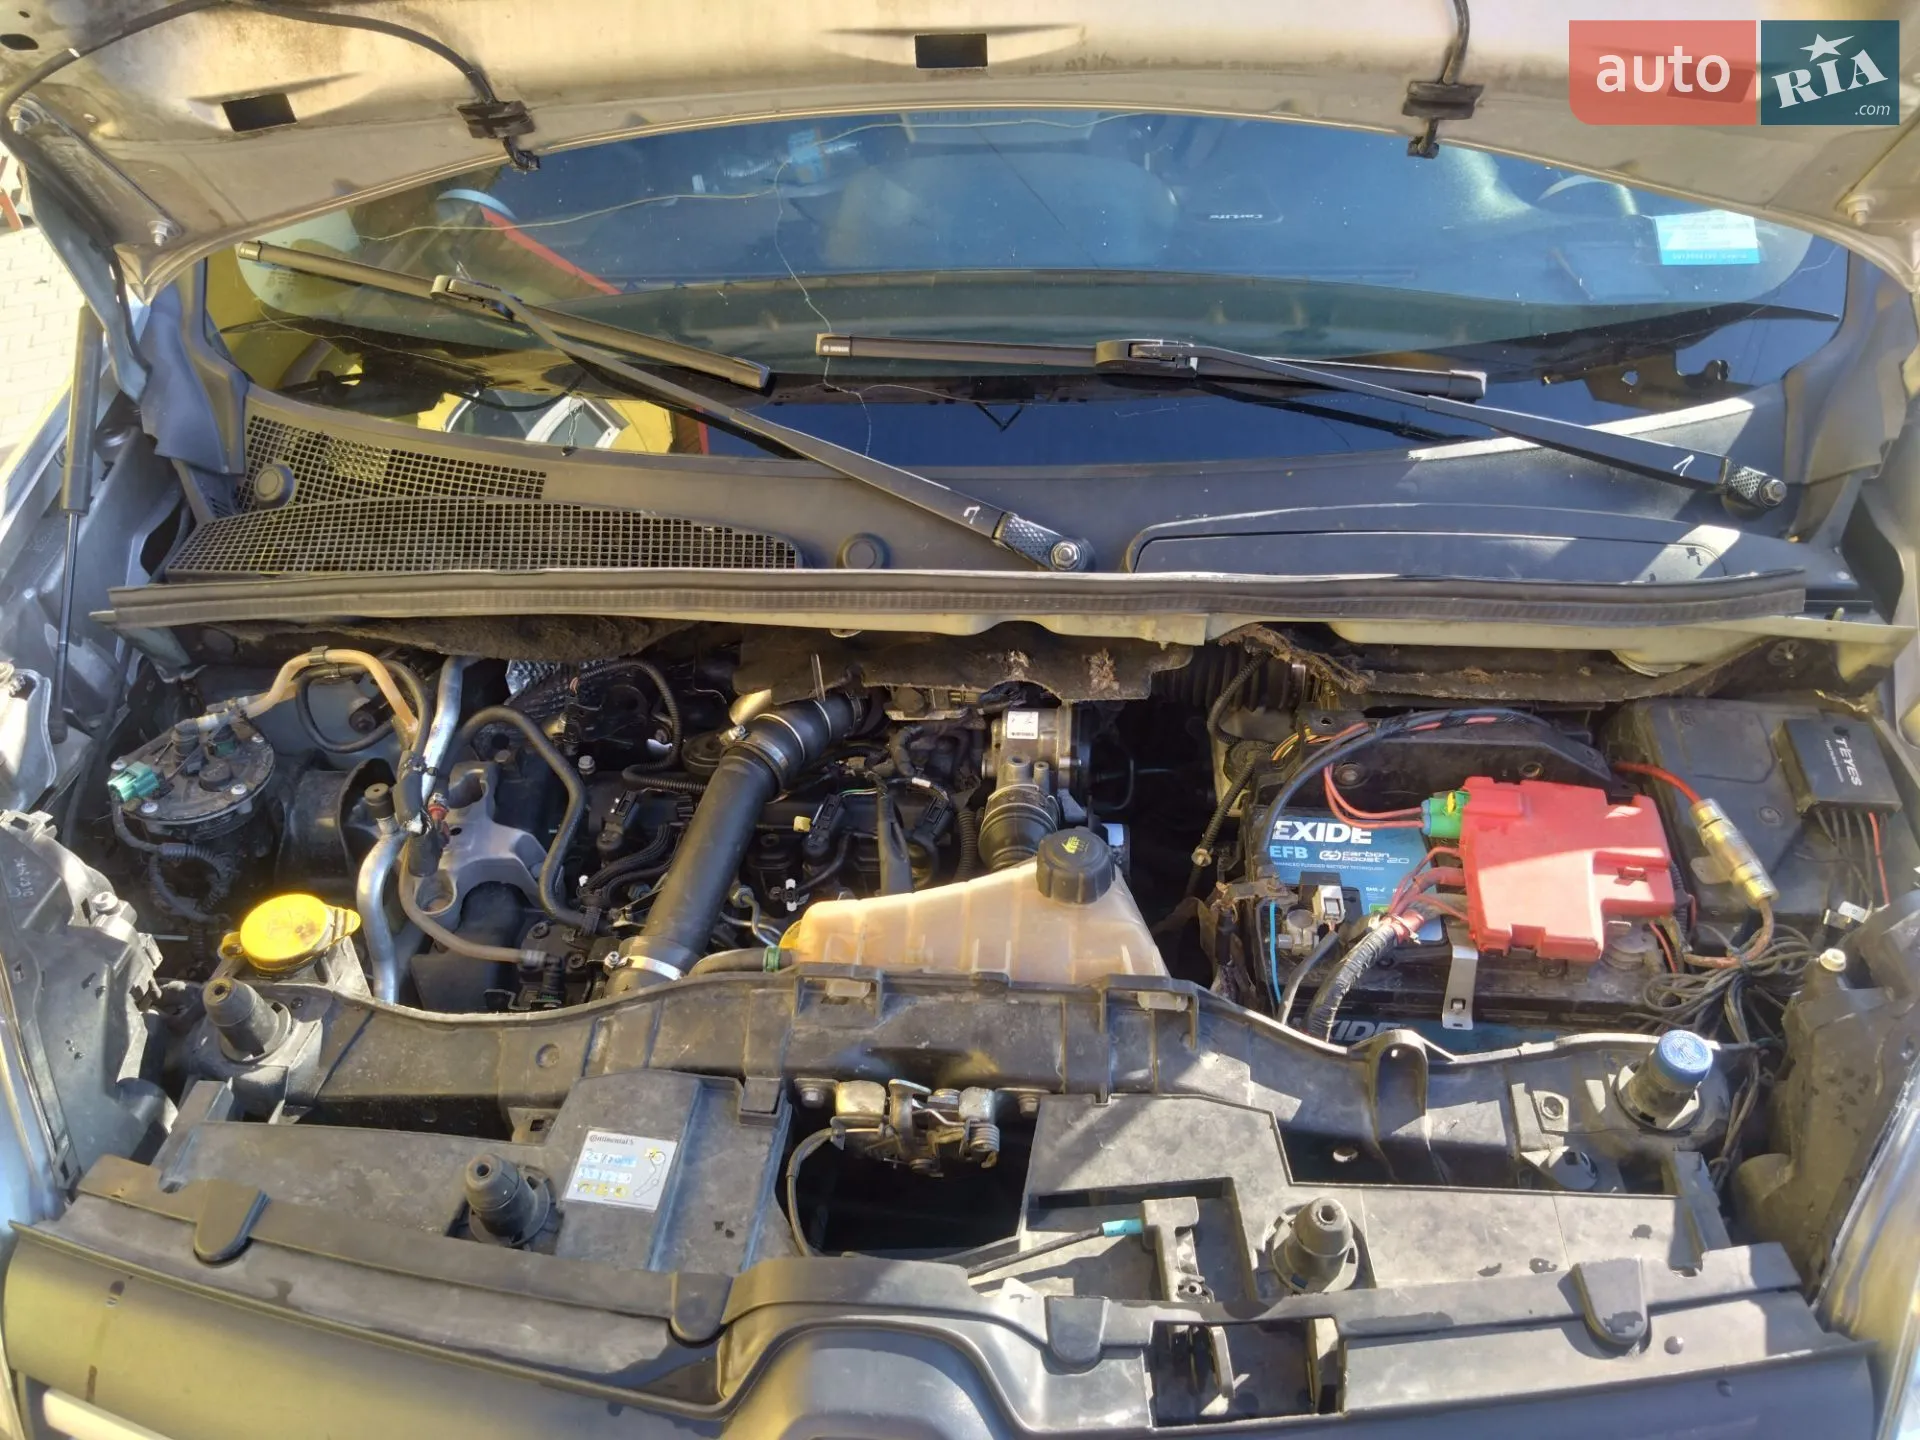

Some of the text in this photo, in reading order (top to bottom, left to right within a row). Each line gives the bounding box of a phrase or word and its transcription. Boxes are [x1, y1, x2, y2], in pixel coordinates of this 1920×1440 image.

[1836, 737, 1863, 786] TEYES
[1272, 820, 1372, 845] EXIDE
[1269, 845, 1309, 859] EFB
